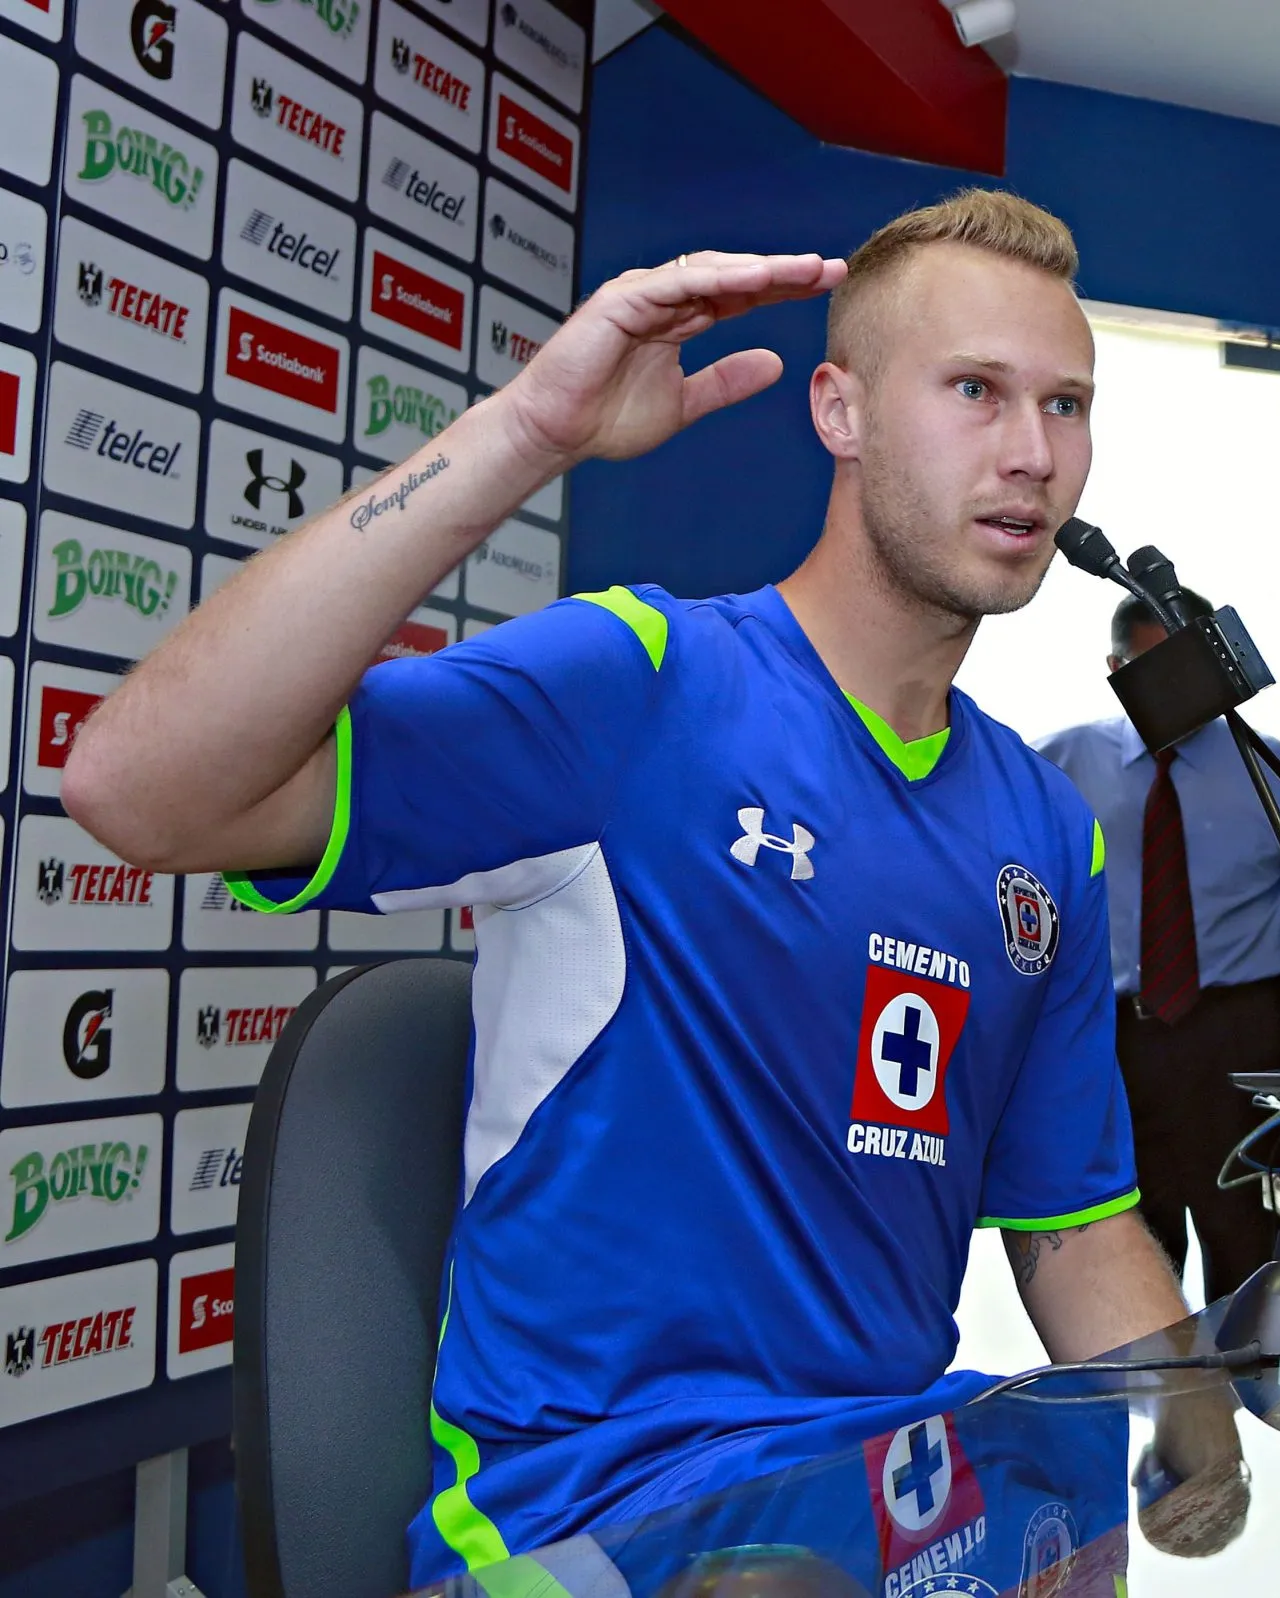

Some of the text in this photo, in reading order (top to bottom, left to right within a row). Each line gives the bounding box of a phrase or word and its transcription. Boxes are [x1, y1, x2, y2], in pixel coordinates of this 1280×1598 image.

[413, 53, 472, 111] TECATE
[278, 94, 346, 158] TECATE
[517, 127, 564, 167] Scotiabank
[78, 109, 204, 204] BOING!
[405, 169, 466, 221] telcel
[267, 222, 341, 277] telcel
[108, 277, 189, 340] TECATE
[396, 286, 454, 324] Scotiabank
[256, 343, 326, 384] Scotiabank
[511, 333, 543, 365] TEC
[97, 420, 182, 477] telcel
[350, 452, 451, 533] Semplicità
[231, 513, 268, 533] UNDER
[48, 538, 178, 617] BOING!
[68, 862, 153, 905] TECATE
[867, 932, 972, 989] CEMENTO
[62, 988, 114, 1079] G
[847, 1123, 946, 1167] CRUZ AZUL
[4, 1141, 149, 1243] BOING!
[40, 1306, 137, 1368] TECATE
